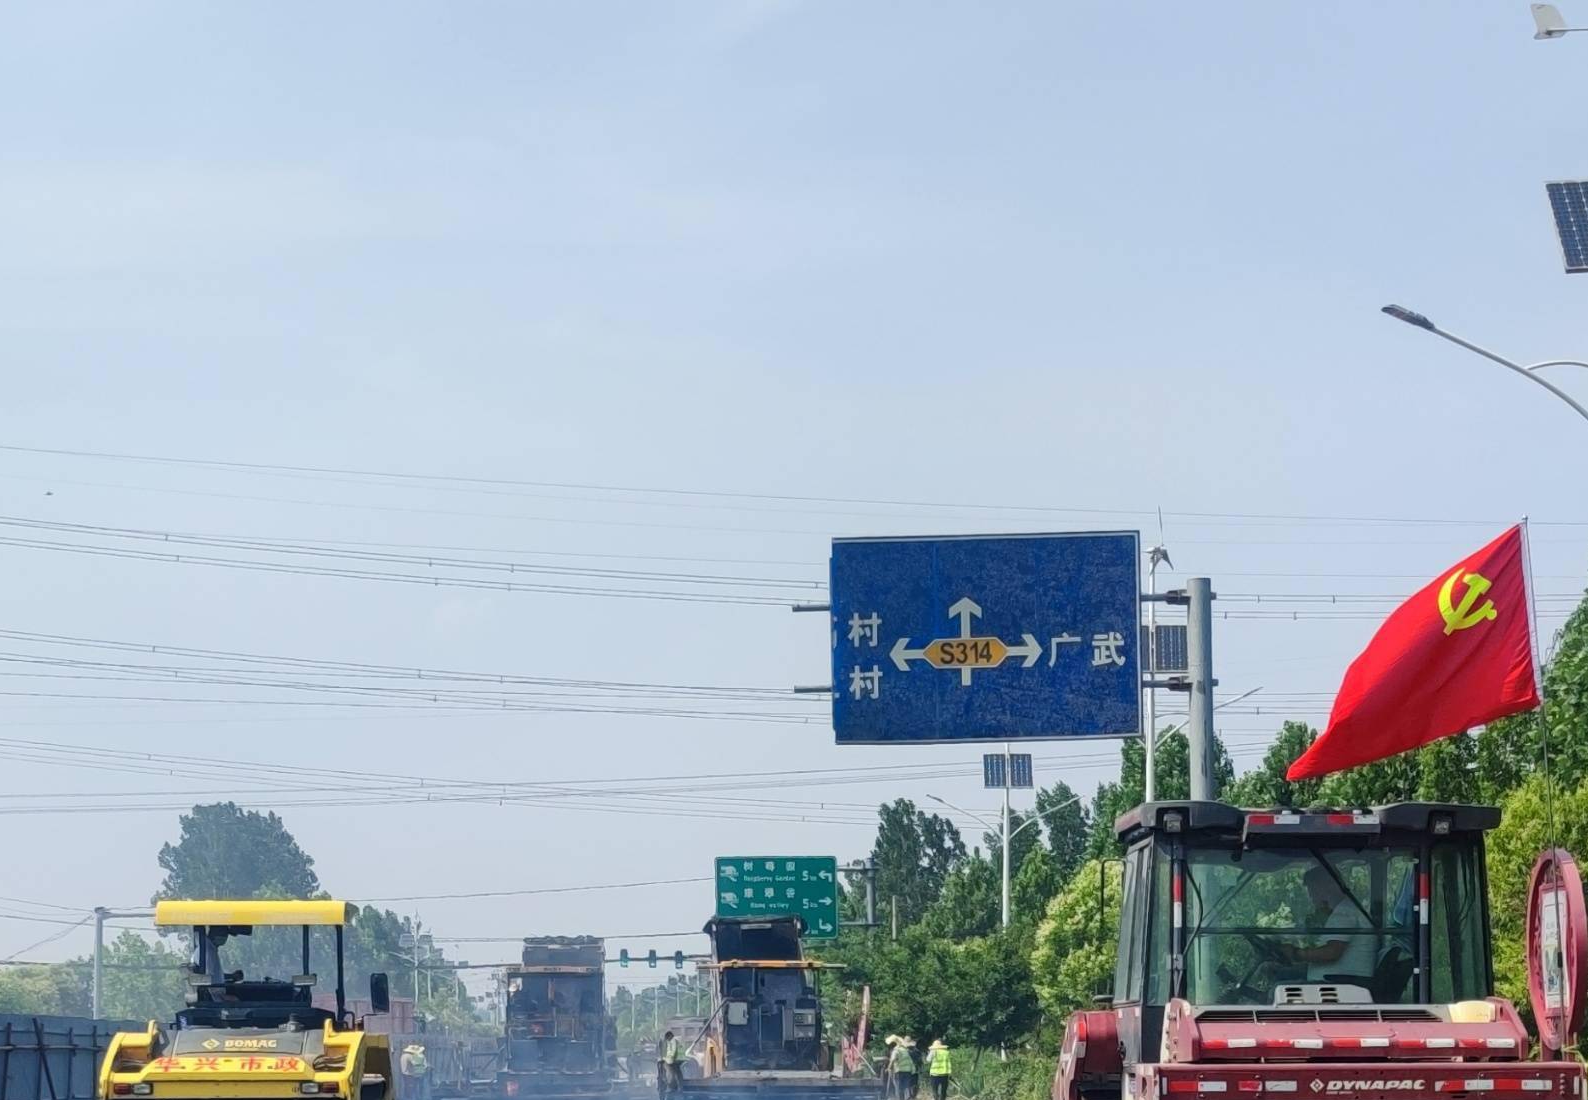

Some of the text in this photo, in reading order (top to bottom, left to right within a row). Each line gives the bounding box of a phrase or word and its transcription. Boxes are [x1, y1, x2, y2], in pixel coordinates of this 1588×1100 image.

[833, 612, 883, 648] 村
[939, 641, 993, 665] S314
[1048, 631, 1126, 669] 广武
[833, 664, 884, 700] 村
[224, 1039, 277, 1048] BOMAG
[154, 1056, 300, 1073] 华兴市政
[1326, 1079, 1426, 1090] DYNAPAC
